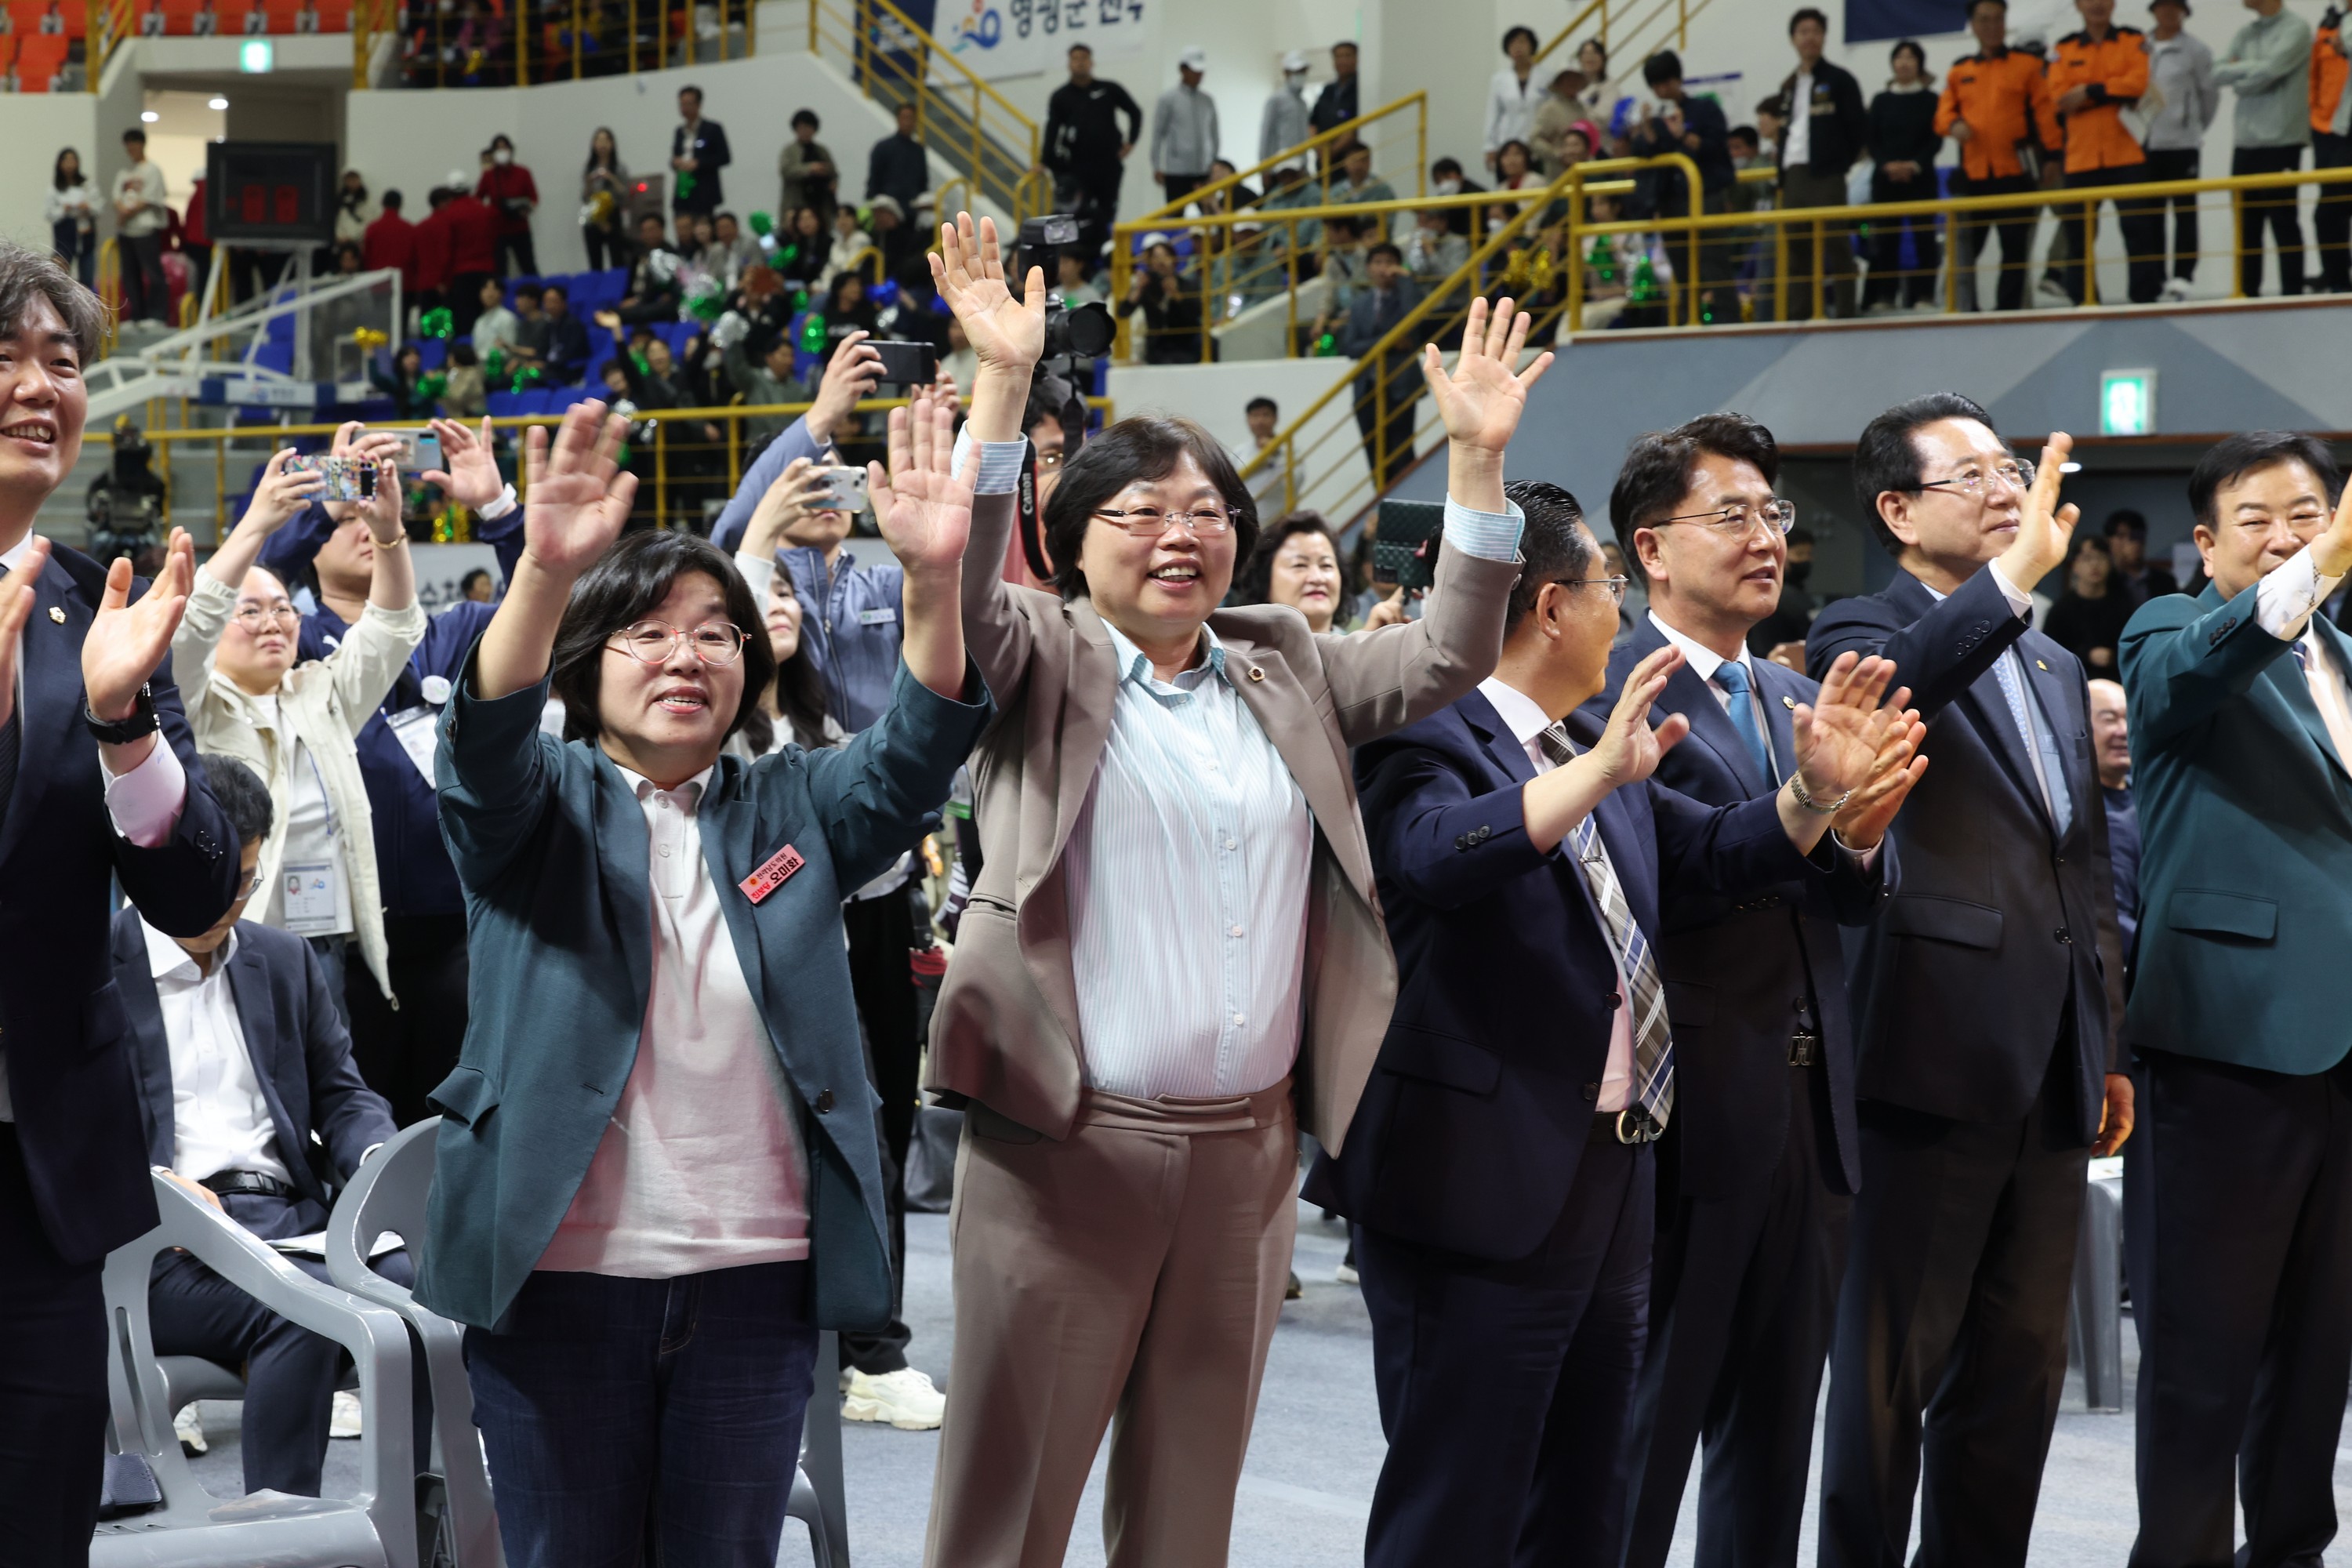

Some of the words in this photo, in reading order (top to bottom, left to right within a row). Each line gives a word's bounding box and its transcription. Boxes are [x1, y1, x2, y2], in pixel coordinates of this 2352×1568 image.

[1011, 0, 1087, 38] 영광군
[1022, 472, 1033, 515] Canon
[751, 881, 771, 899] 진보당
[769, 856, 800, 884] 오미화
[756, 852, 788, 880] 전라남도의원
